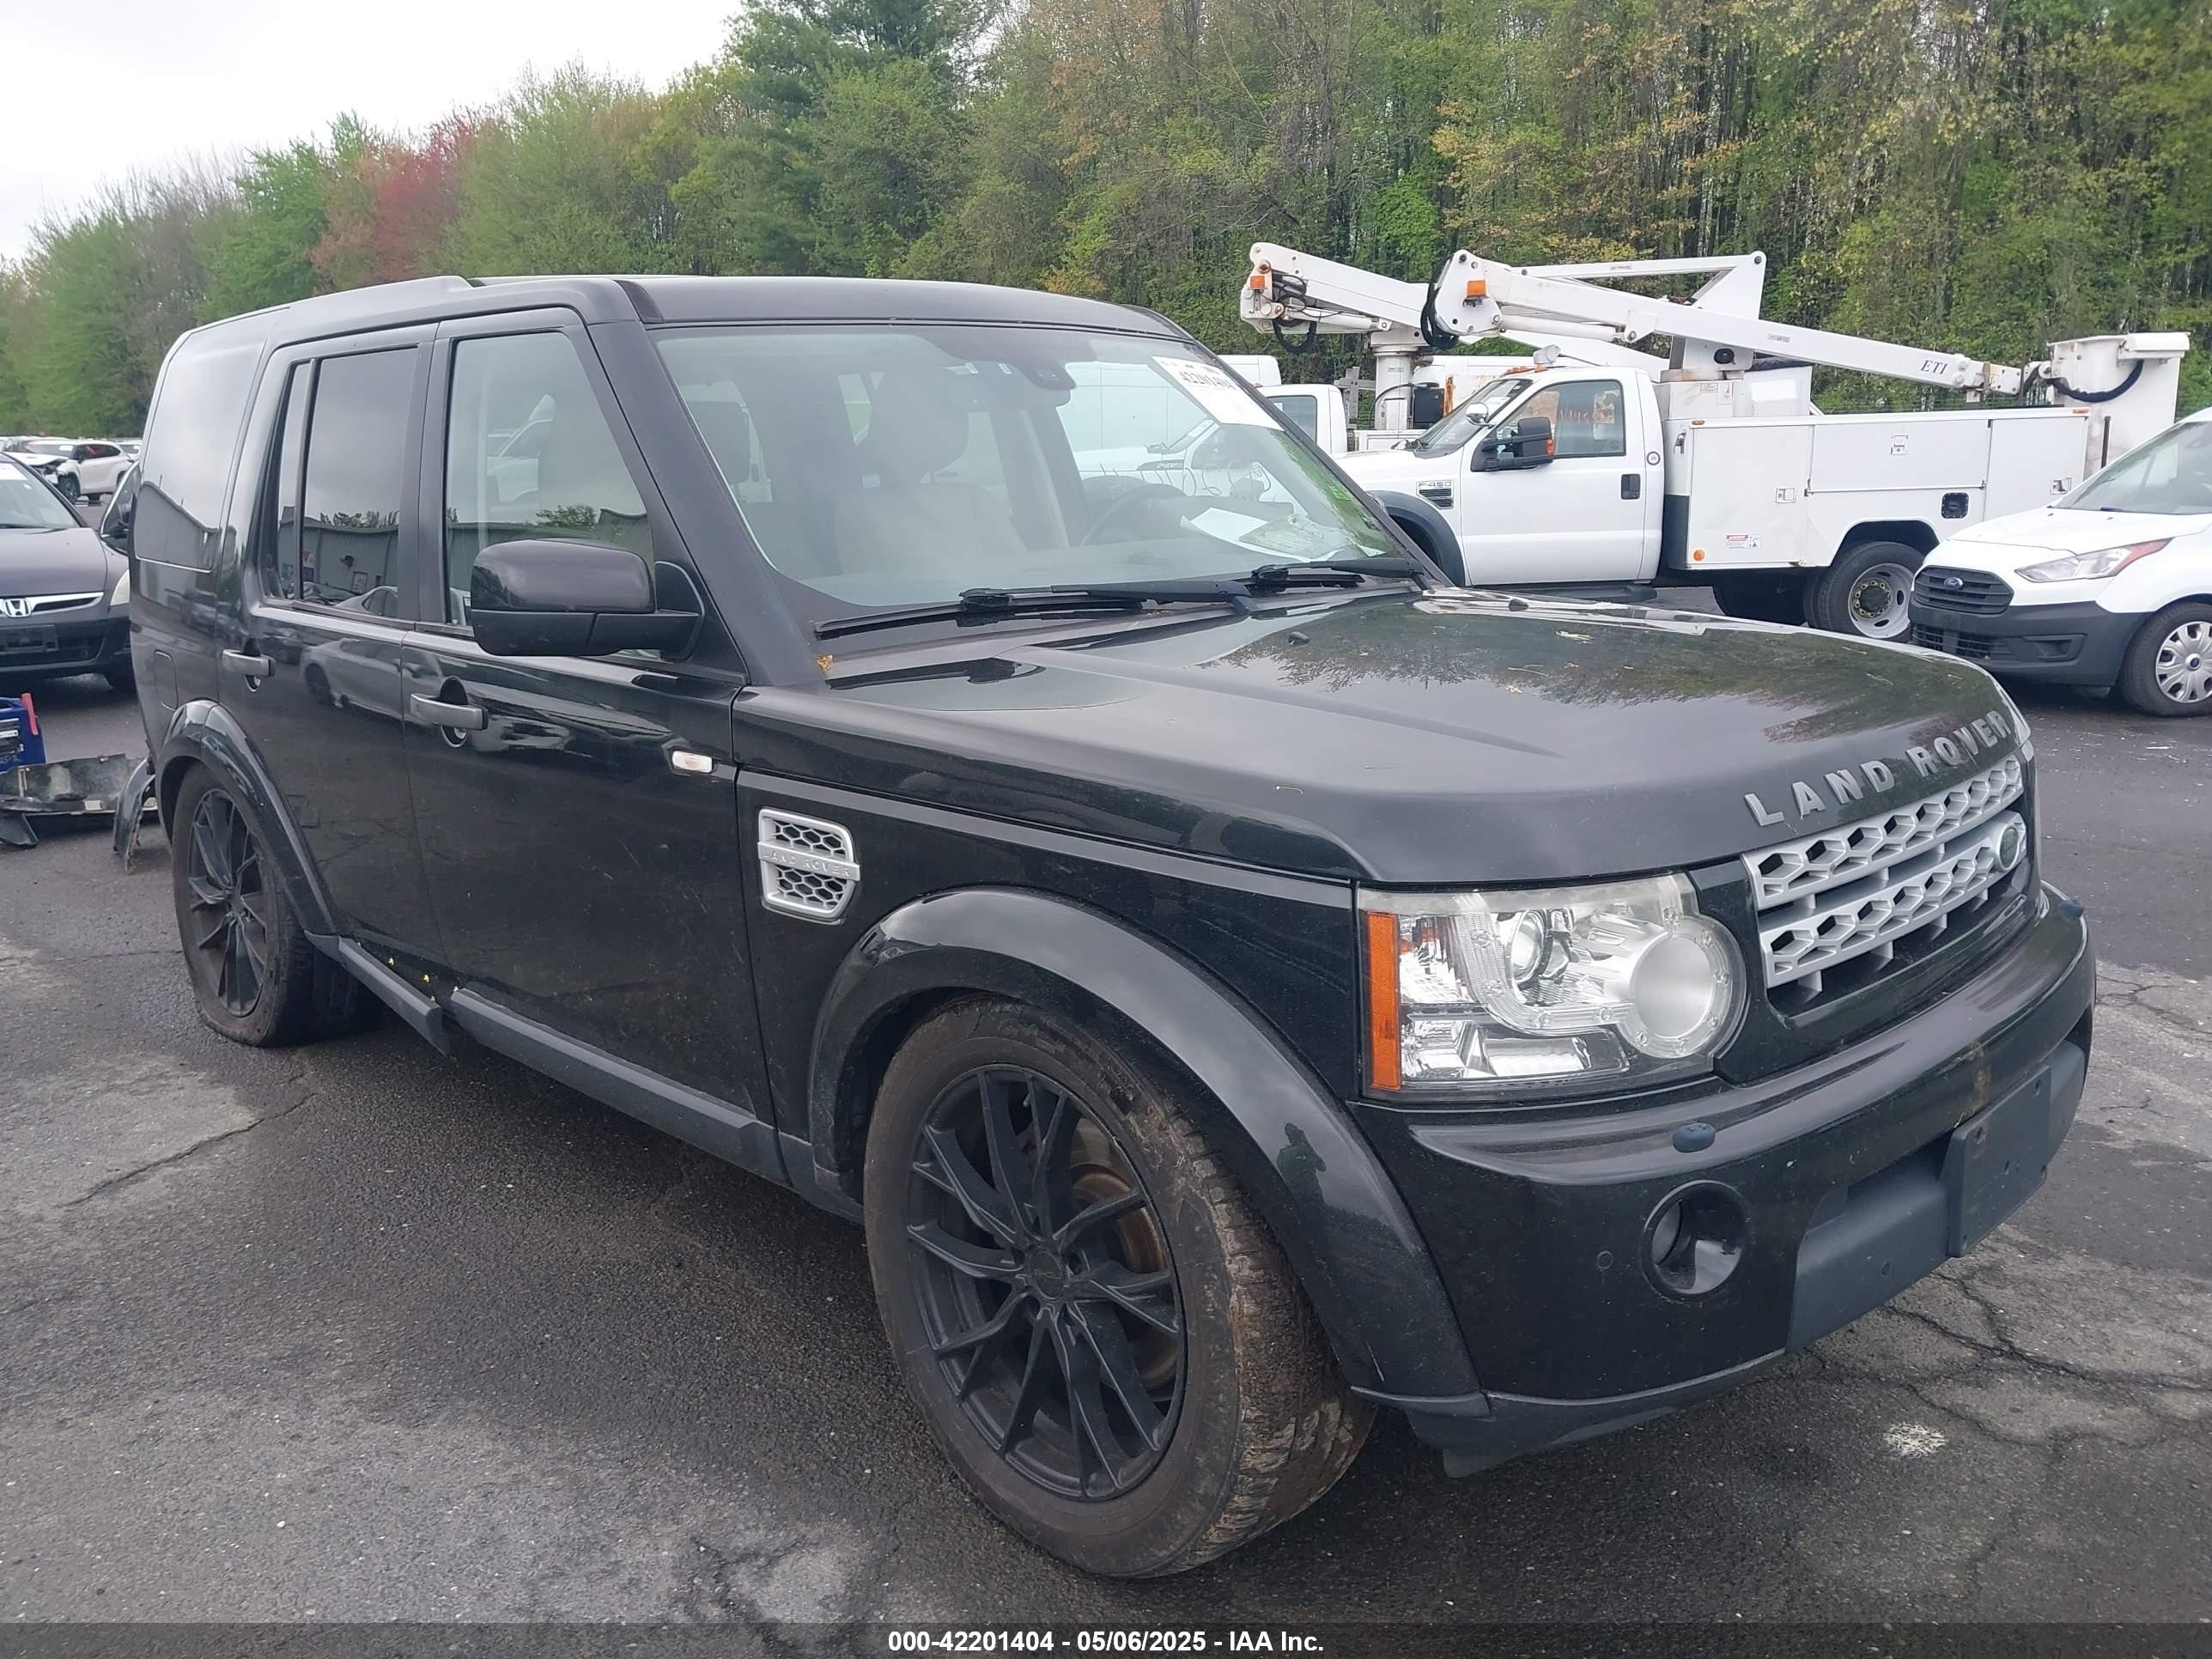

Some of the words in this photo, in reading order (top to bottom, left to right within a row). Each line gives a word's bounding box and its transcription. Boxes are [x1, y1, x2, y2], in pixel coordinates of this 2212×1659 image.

[1920, 359, 1948, 375] ETI
[1744, 760, 1895, 826] LAND
[1905, 710, 2012, 777] ROVER
[802, 859, 850, 878] ROVER
